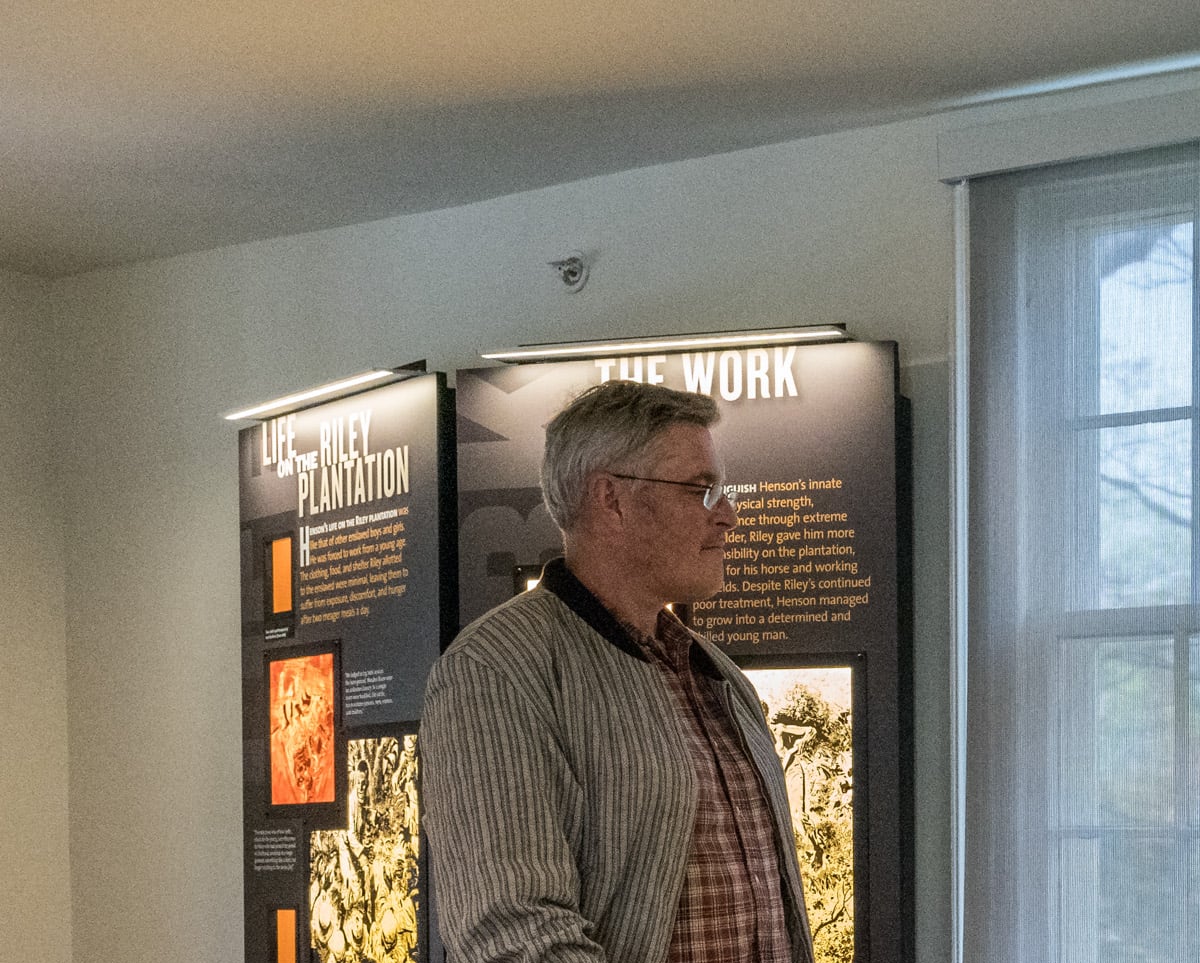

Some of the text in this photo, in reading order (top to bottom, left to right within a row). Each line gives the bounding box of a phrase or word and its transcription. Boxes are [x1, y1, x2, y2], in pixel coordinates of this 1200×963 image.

[682, 346, 798, 402] WORK
[262, 409, 372, 479] LIFE ON THE RILEY
[298, 445, 410, 518] PLANTATION
[759, 478, 806, 492] Henson's
[808, 478, 842, 490] innate
[766, 495, 814, 511] strength,
[758, 511, 800, 528] through
[802, 512, 848, 523] extreme
[749, 529, 773, 545] Riley
[776, 531, 800, 544] gave
[803, 527, 824, 539] him
[826, 529, 855, 538] more
[761, 549, 776, 558] on
[778, 545, 796, 557] the
[798, 543, 855, 560] plantation,
[726, 559, 858, 575] for his horse and working
[741, 579, 781, 595] Despite
[783, 577, 816, 594] Riley's
[818, 575, 872, 589] continued
[692, 592, 869, 613] poor treatment, Henson managed
[692, 609, 852, 629] to grow into a determined and
[727, 632, 760, 645] young
[762, 631, 788, 640] man.
